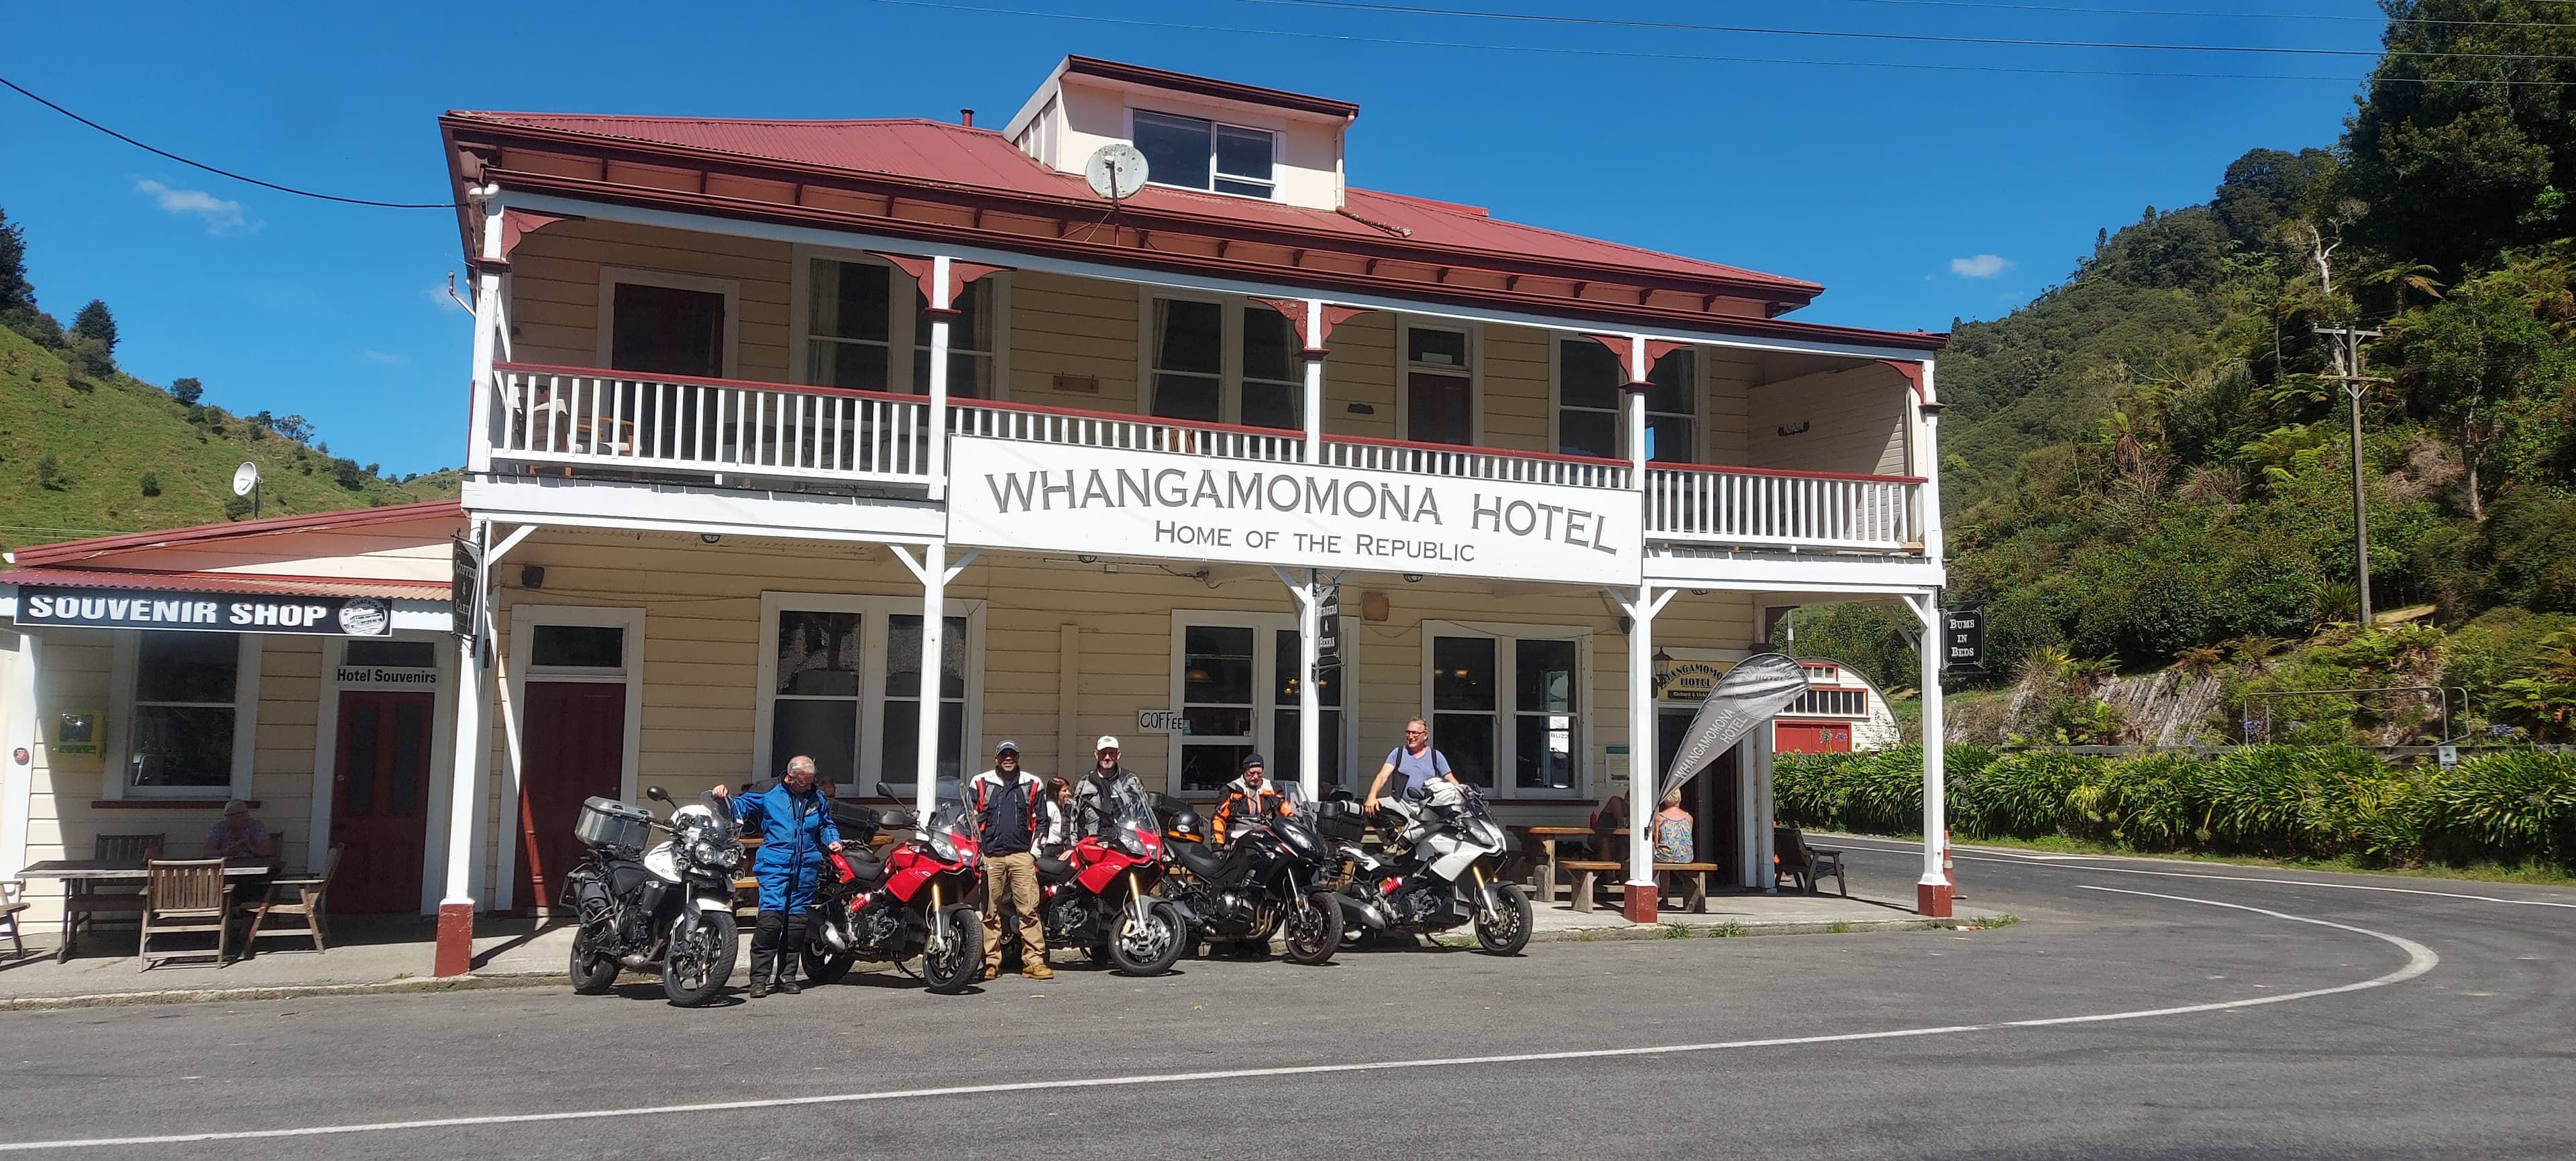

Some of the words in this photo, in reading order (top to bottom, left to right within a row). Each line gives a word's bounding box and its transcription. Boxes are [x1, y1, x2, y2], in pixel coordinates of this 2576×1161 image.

[984, 467, 1443, 525] WHANGAMOMONA
[1471, 493, 1617, 556] HOTEL
[1155, 520, 1232, 547] HOME
[1246, 530, 1279, 549] OF
[1293, 533, 1342, 554] THE
[1356, 534, 1475, 562] REPUBLIC
[28, 594, 217, 624] SOUVENIR
[229, 603, 327, 627] SHOP
[1949, 618, 1975, 629] BUMS
[1957, 634, 1968, 643] IN
[1951, 647, 1974, 657] BEDS
[337, 668, 370, 682] Hotel
[374, 669, 437, 683] Souvenirs
[1680, 677, 1711, 688] HOTEL
[1140, 712, 1183, 730] COFFEE
[1719, 717, 1749, 744] HOTEL
[1674, 708, 1736, 779] WHANGAMOMONA
